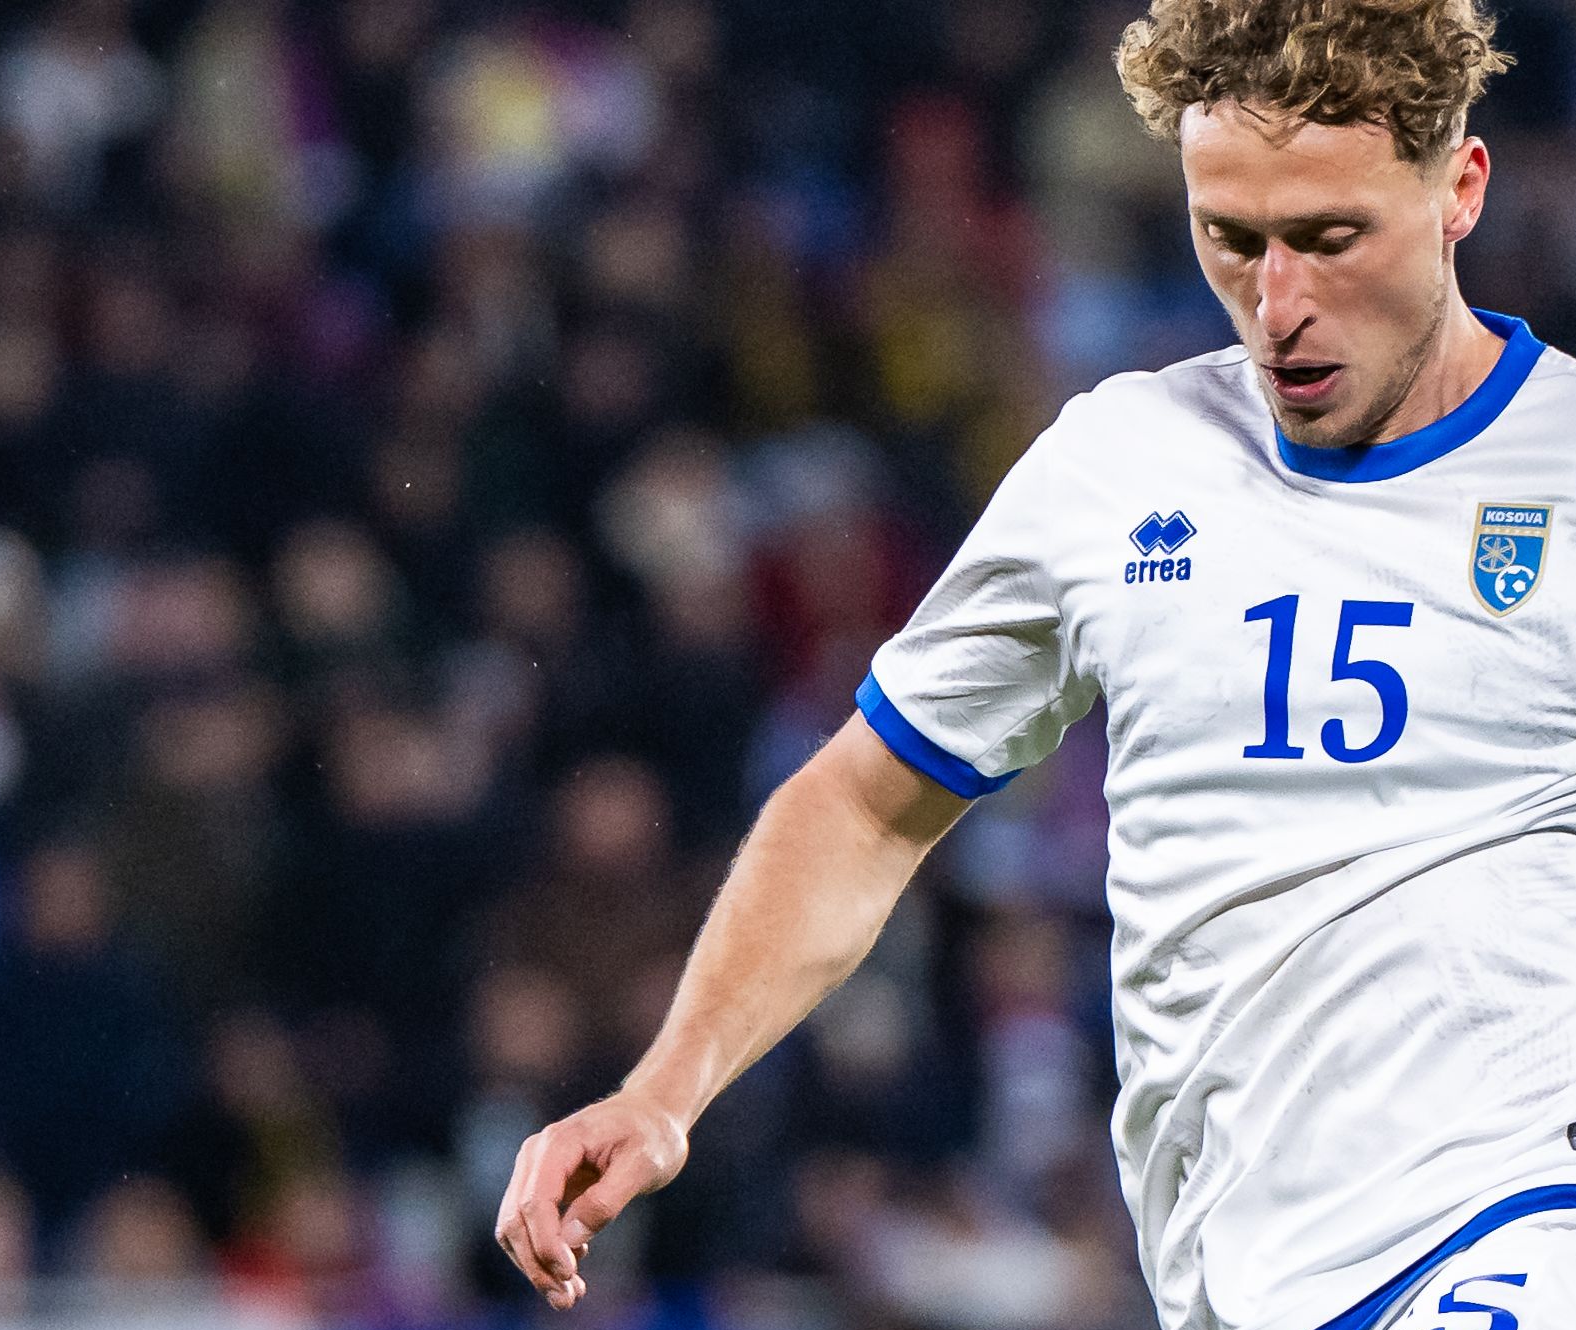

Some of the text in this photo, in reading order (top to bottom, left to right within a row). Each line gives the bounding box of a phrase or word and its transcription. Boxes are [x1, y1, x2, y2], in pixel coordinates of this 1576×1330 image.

[1485, 510, 1544, 524] KOSOVA
[1124, 557, 1192, 584] errea
[1243, 594, 1415, 764] 15
